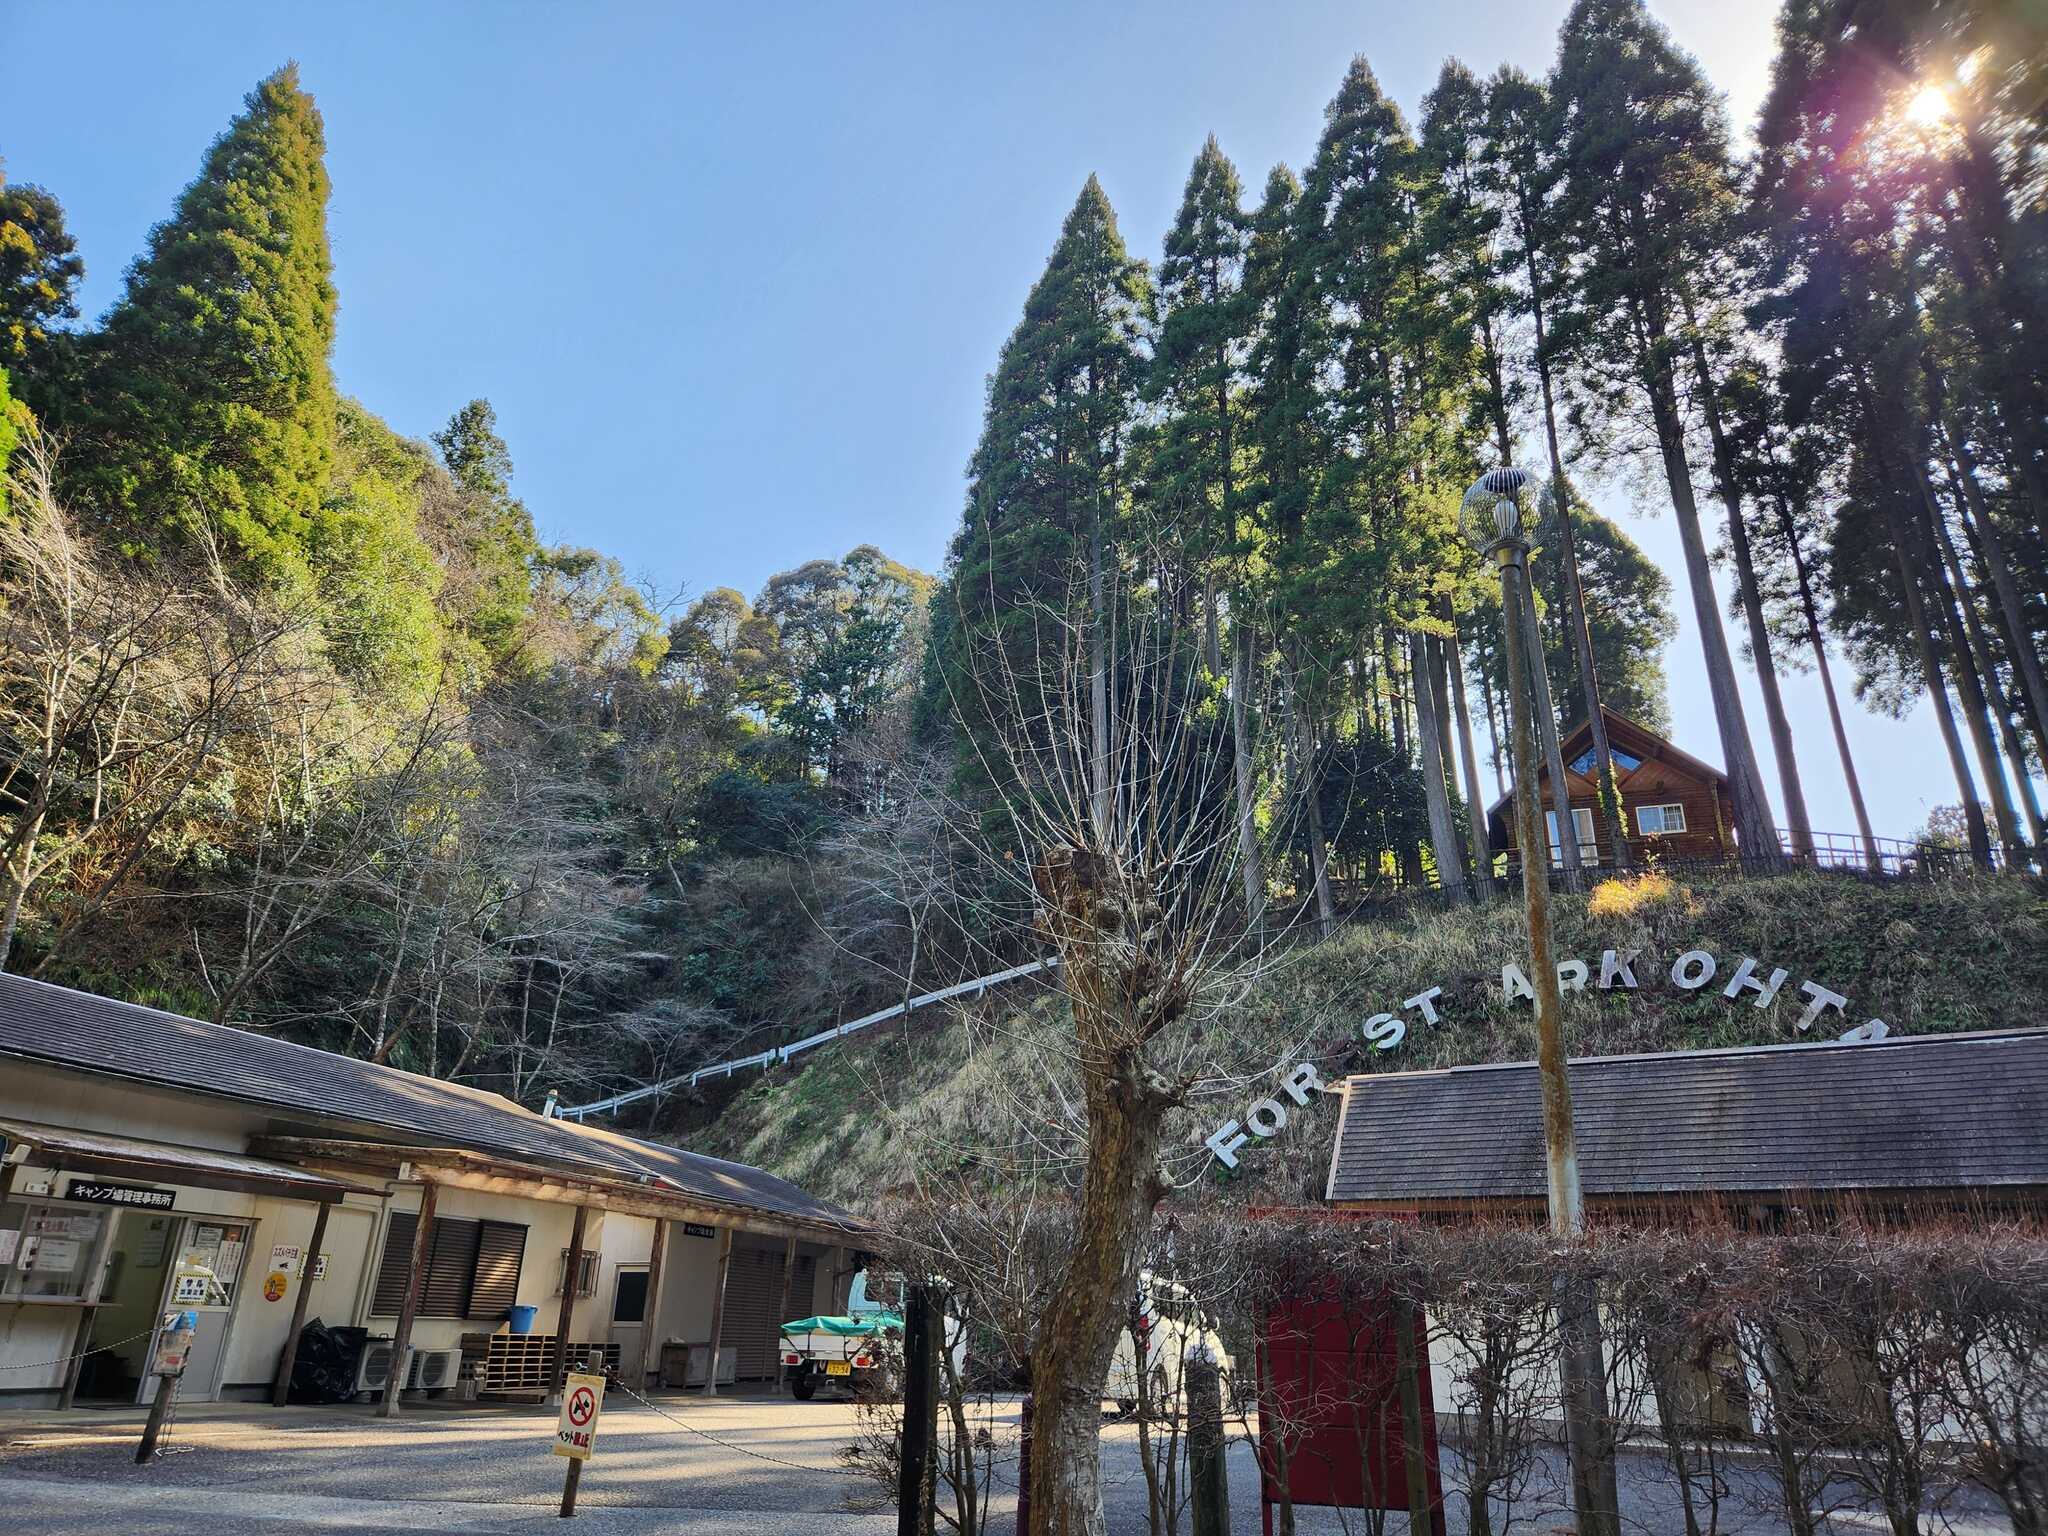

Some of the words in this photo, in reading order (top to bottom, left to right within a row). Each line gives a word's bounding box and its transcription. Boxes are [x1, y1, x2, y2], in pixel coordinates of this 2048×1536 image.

[74, 1184, 173, 1206] キャンプ場管理事務所
[558, 1430, 591, 1449] ペット禁止
